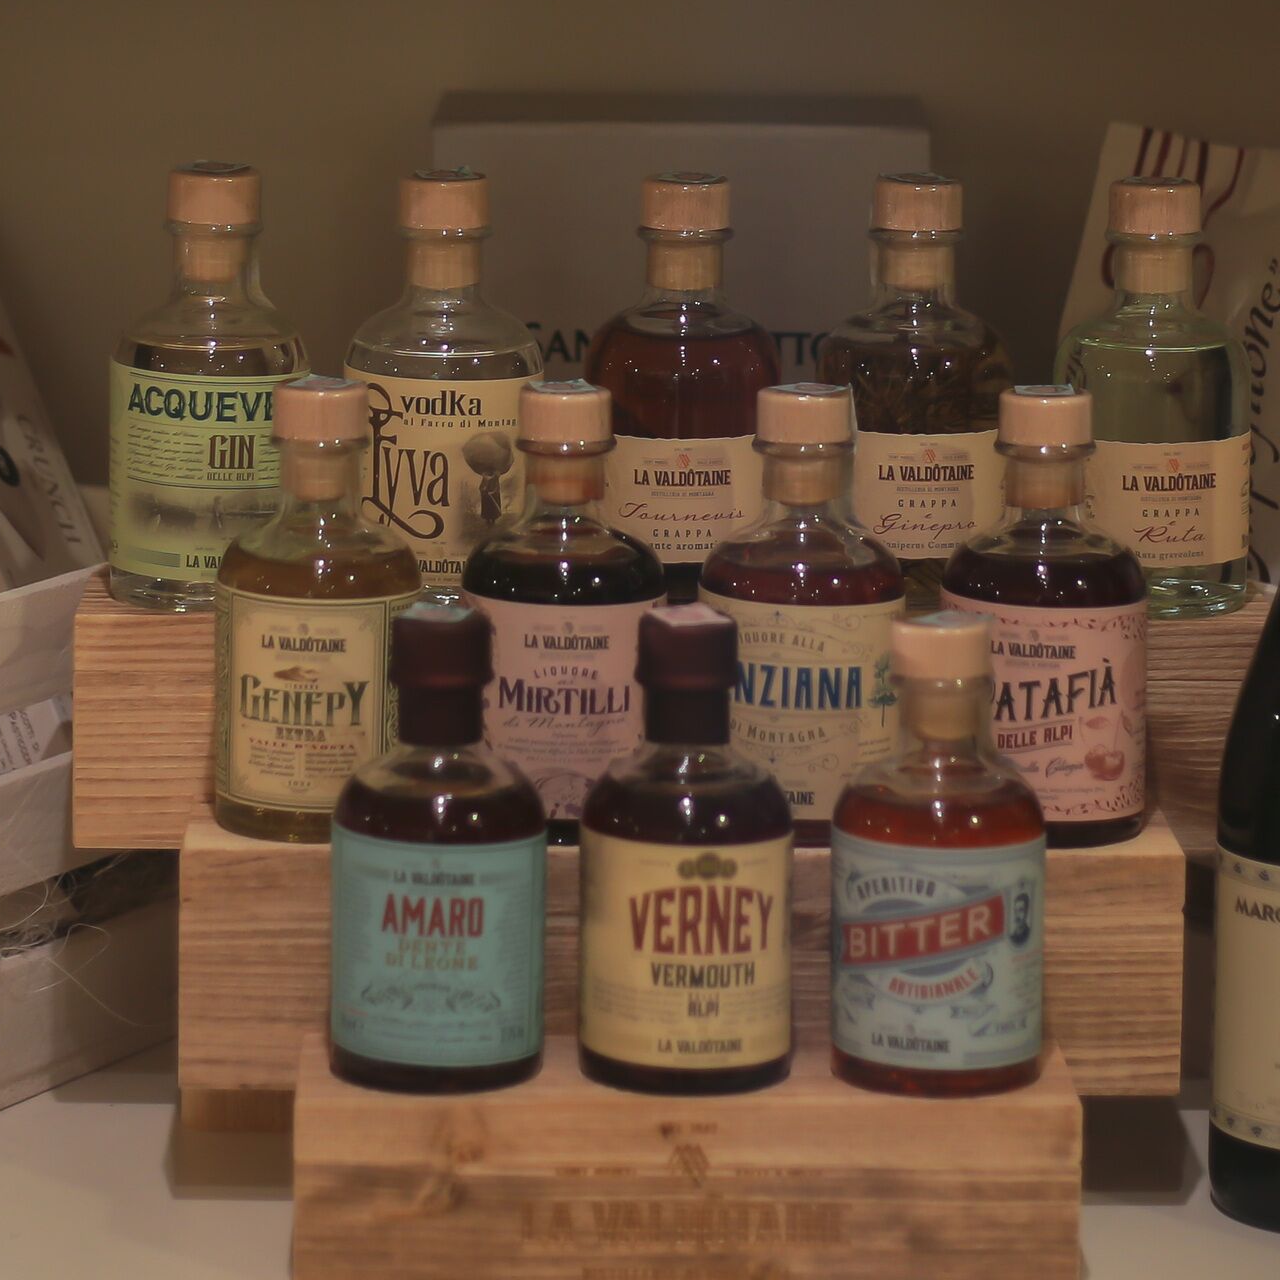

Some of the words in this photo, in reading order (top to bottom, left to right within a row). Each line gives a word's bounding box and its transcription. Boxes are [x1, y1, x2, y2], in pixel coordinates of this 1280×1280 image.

[420, 418, 454, 429] Farro
[460, 419, 471, 428] di
[207, 434, 257, 470] GIN
[634, 468, 651, 486] LA
[654, 467, 732, 487] VALDÔTAINE
[878, 464, 895, 482] LA
[899, 463, 975, 483] VALDÔTAINE
[1122, 475, 1139, 492] LA
[1143, 472, 1217, 493] VALDÔTAINE
[897, 499, 958, 508] GRAPPA
[1141, 508, 1200, 519] GRAPPA
[652, 528, 713, 538] GRAPPA
[872, 513, 979, 541] Ginepro
[1131, 525, 1208, 544] Ruta
[185, 555, 200, 569] LA
[261, 634, 275, 649] LA
[523, 633, 539, 650] LA
[792, 632, 825, 653] ALLA
[991, 640, 1005, 656] LA
[533, 665, 599, 681] LIQUORE
[498, 675, 630, 716] MIRTILLI
[734, 661, 864, 711] NZIANA
[991, 657, 1117, 723] ATAFIÀ
[239, 673, 371, 728] GENEPY
[997, 730, 1038, 750] DELLE
[1043, 724, 1073, 744] ALPI
[380, 891, 486, 939] AMARO
[628, 883, 776, 958] VERNEY
[849, 904, 991, 959] BITTER
[649, 960, 757, 991] VERMOUTH
[656, 1037, 674, 1054] LA
[871, 1031, 885, 1048] LA
